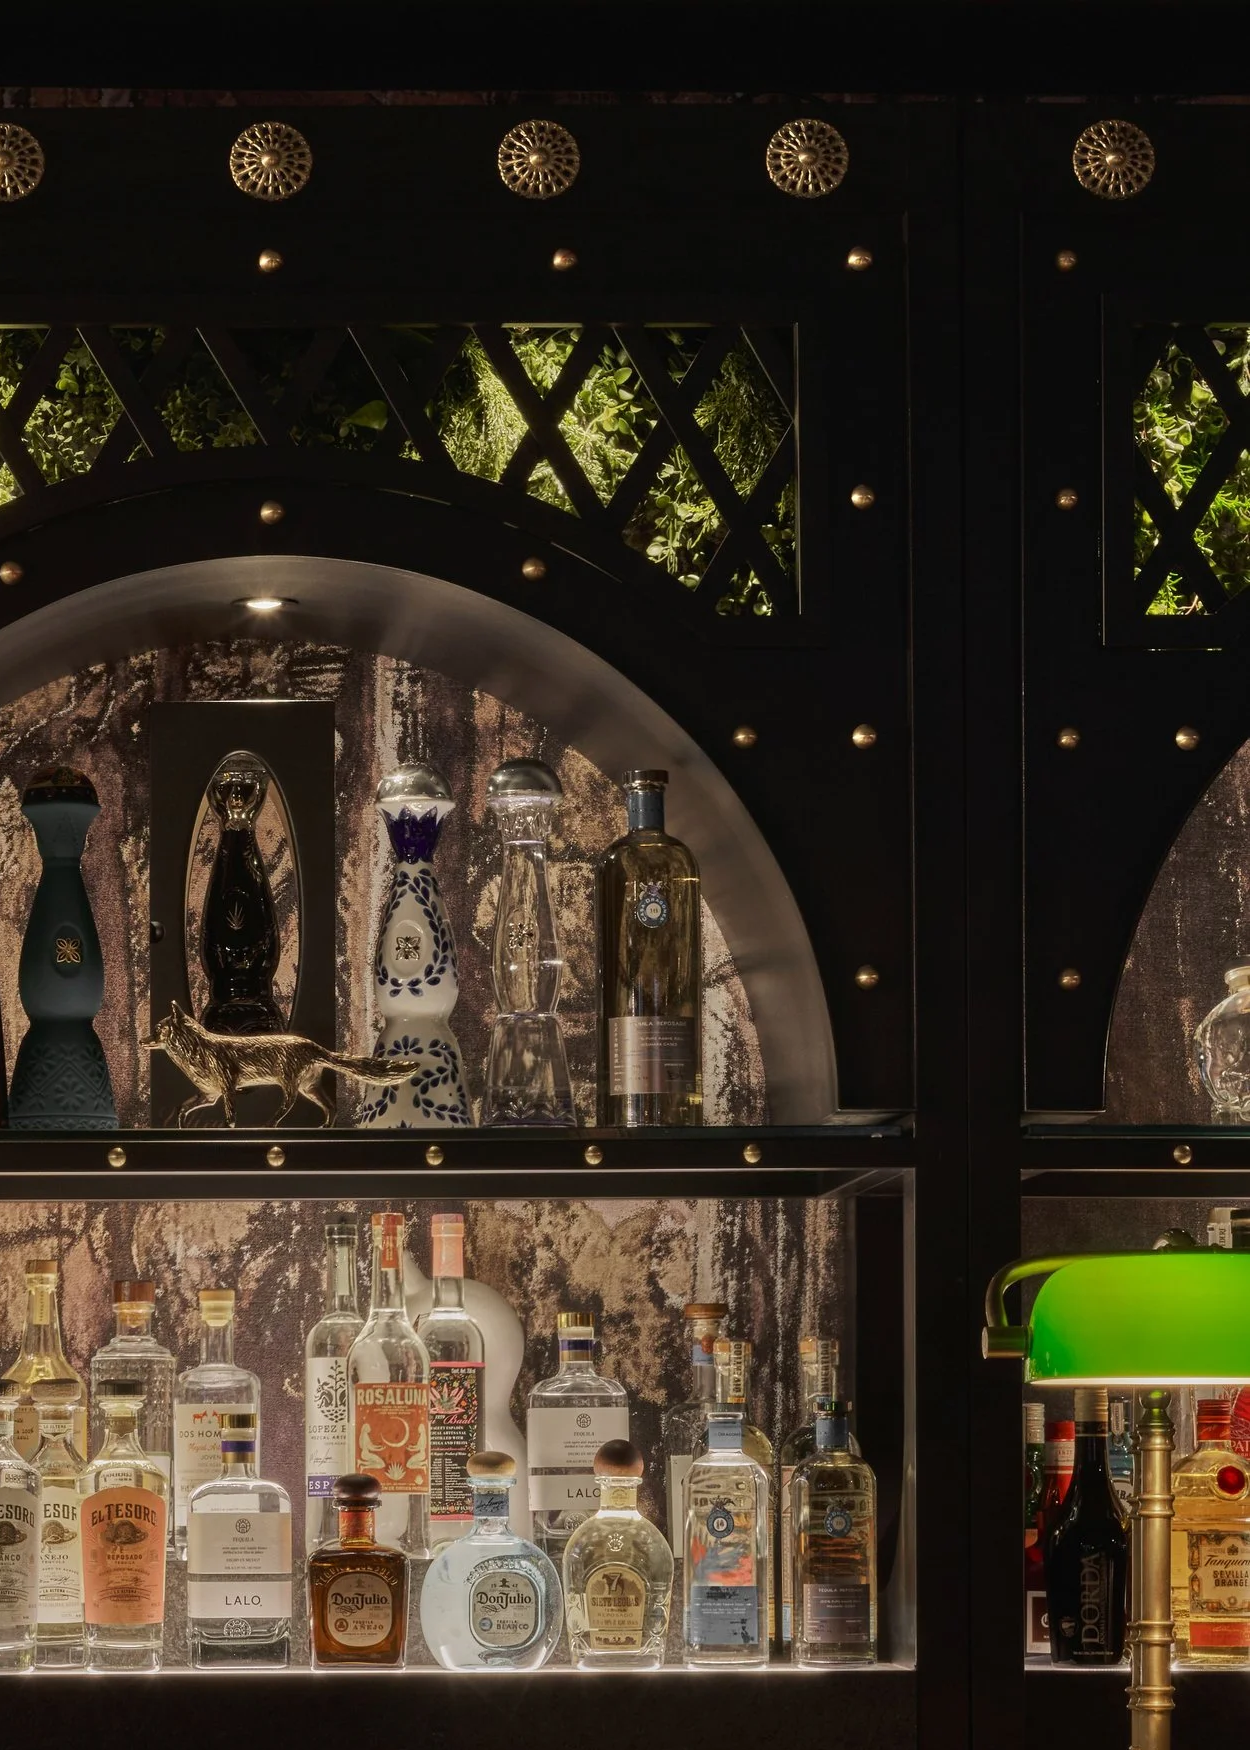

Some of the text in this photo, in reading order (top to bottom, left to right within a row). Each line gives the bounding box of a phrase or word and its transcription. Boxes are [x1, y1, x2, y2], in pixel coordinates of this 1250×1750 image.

[357, 1388, 428, 1405] ROSALUNA
[197, 1430, 222, 1438] HOM
[308, 1480, 330, 1490] ESP
[1213, 1570, 1249, 1579] SEVILLA
[609, 1572, 622, 1591] 7
[1214, 1579, 1248, 1587] ORANGE
